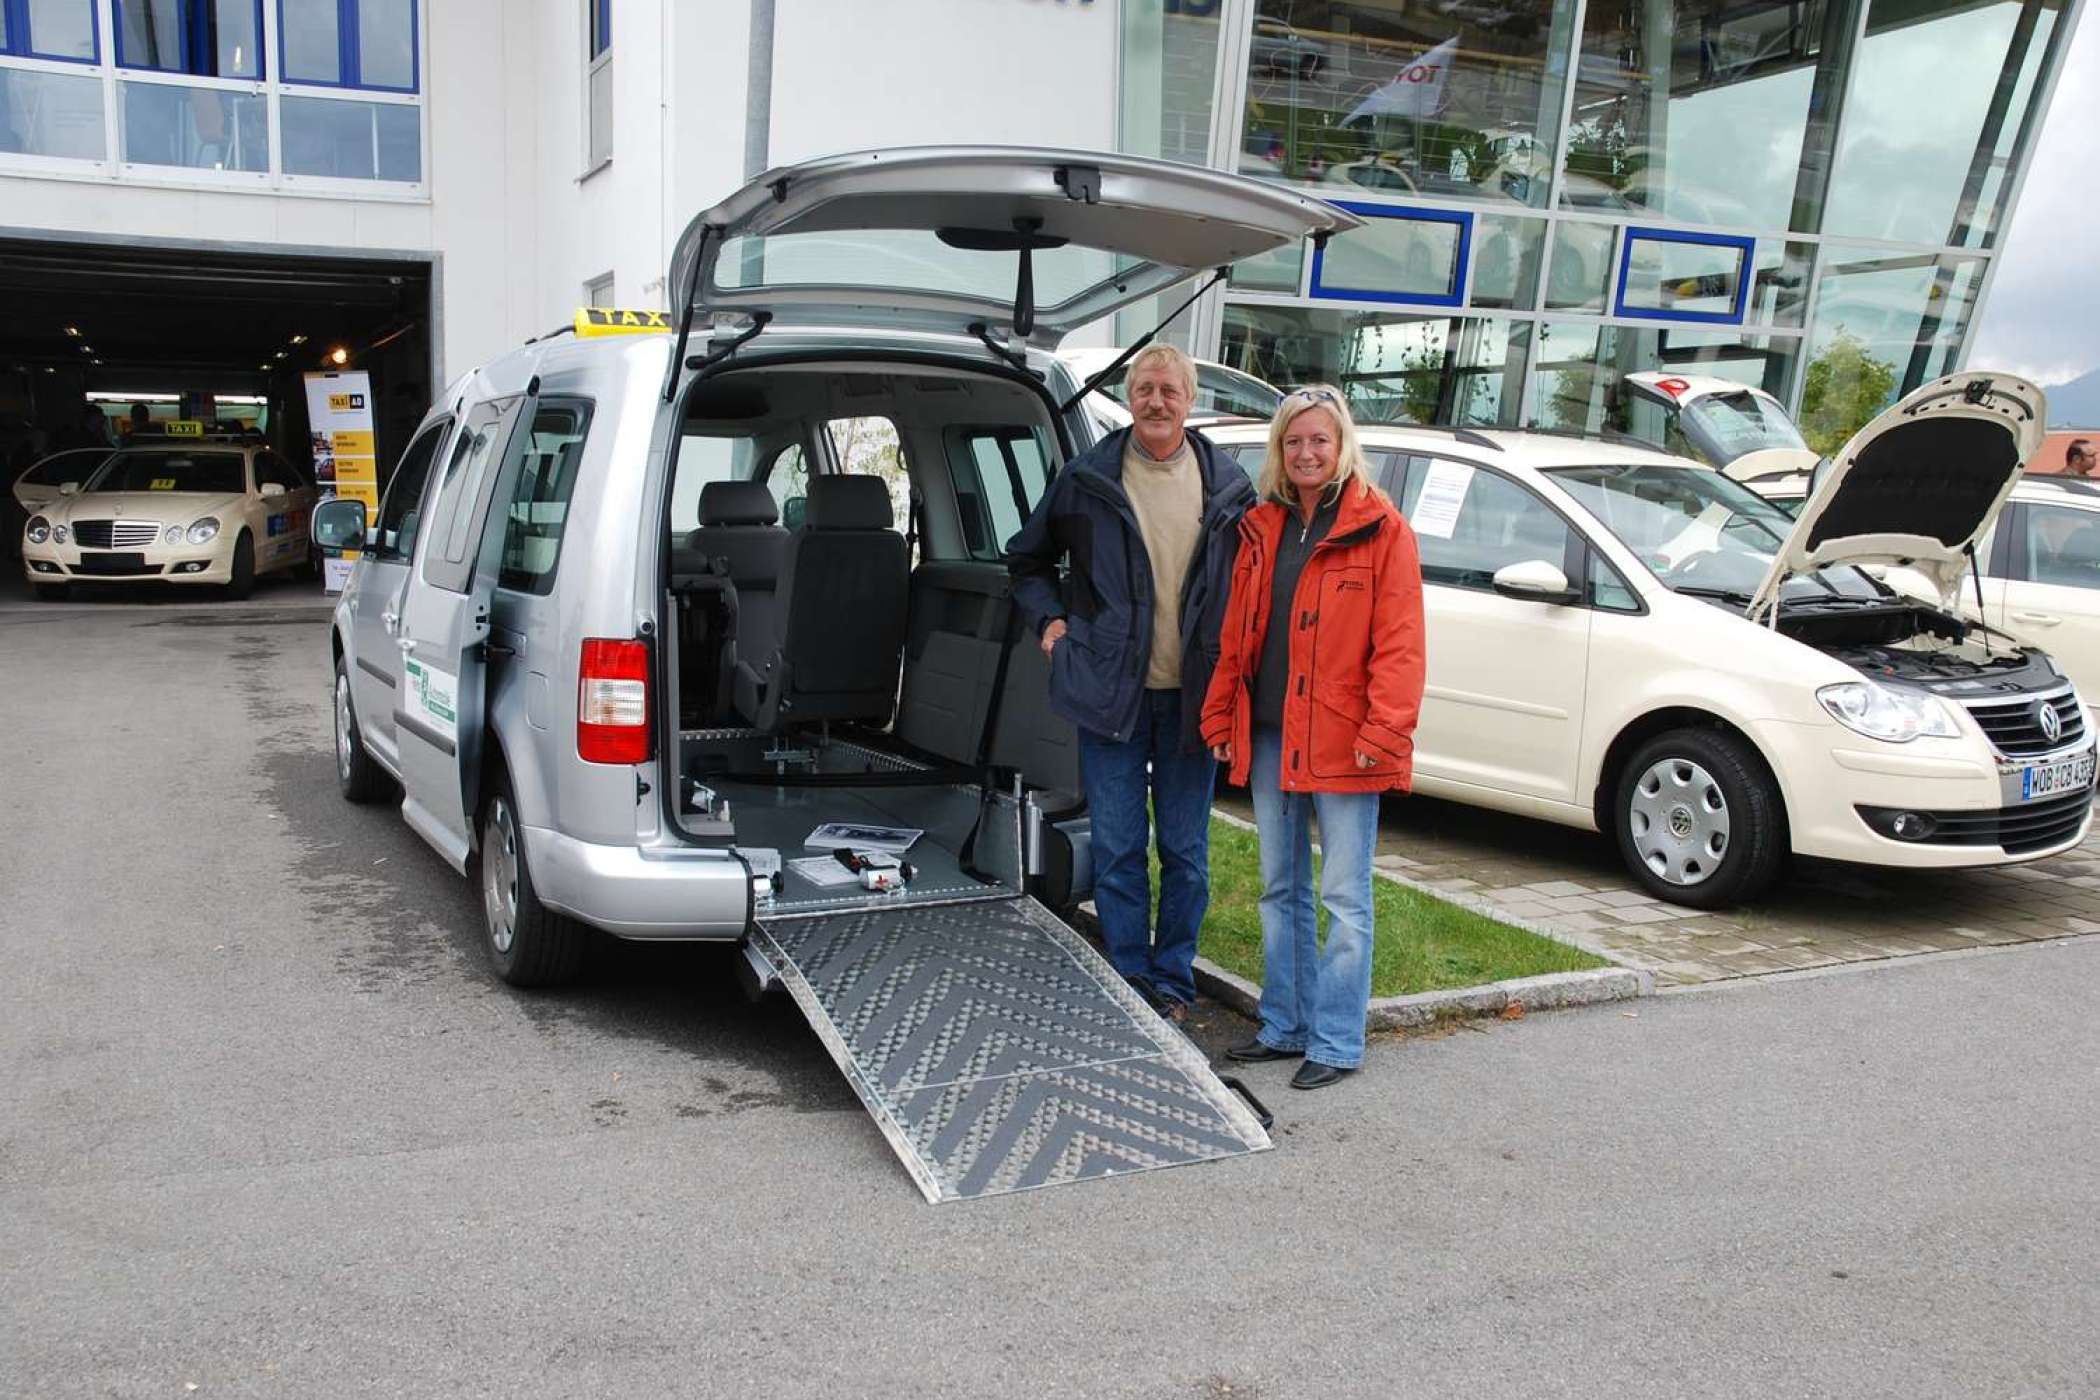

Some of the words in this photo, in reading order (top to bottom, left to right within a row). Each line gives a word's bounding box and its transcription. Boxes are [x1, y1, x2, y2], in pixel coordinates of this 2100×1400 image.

[598, 309, 667, 327] TAX
[169, 423, 197, 434] TAXI
[2032, 766, 2054, 793] WOB
